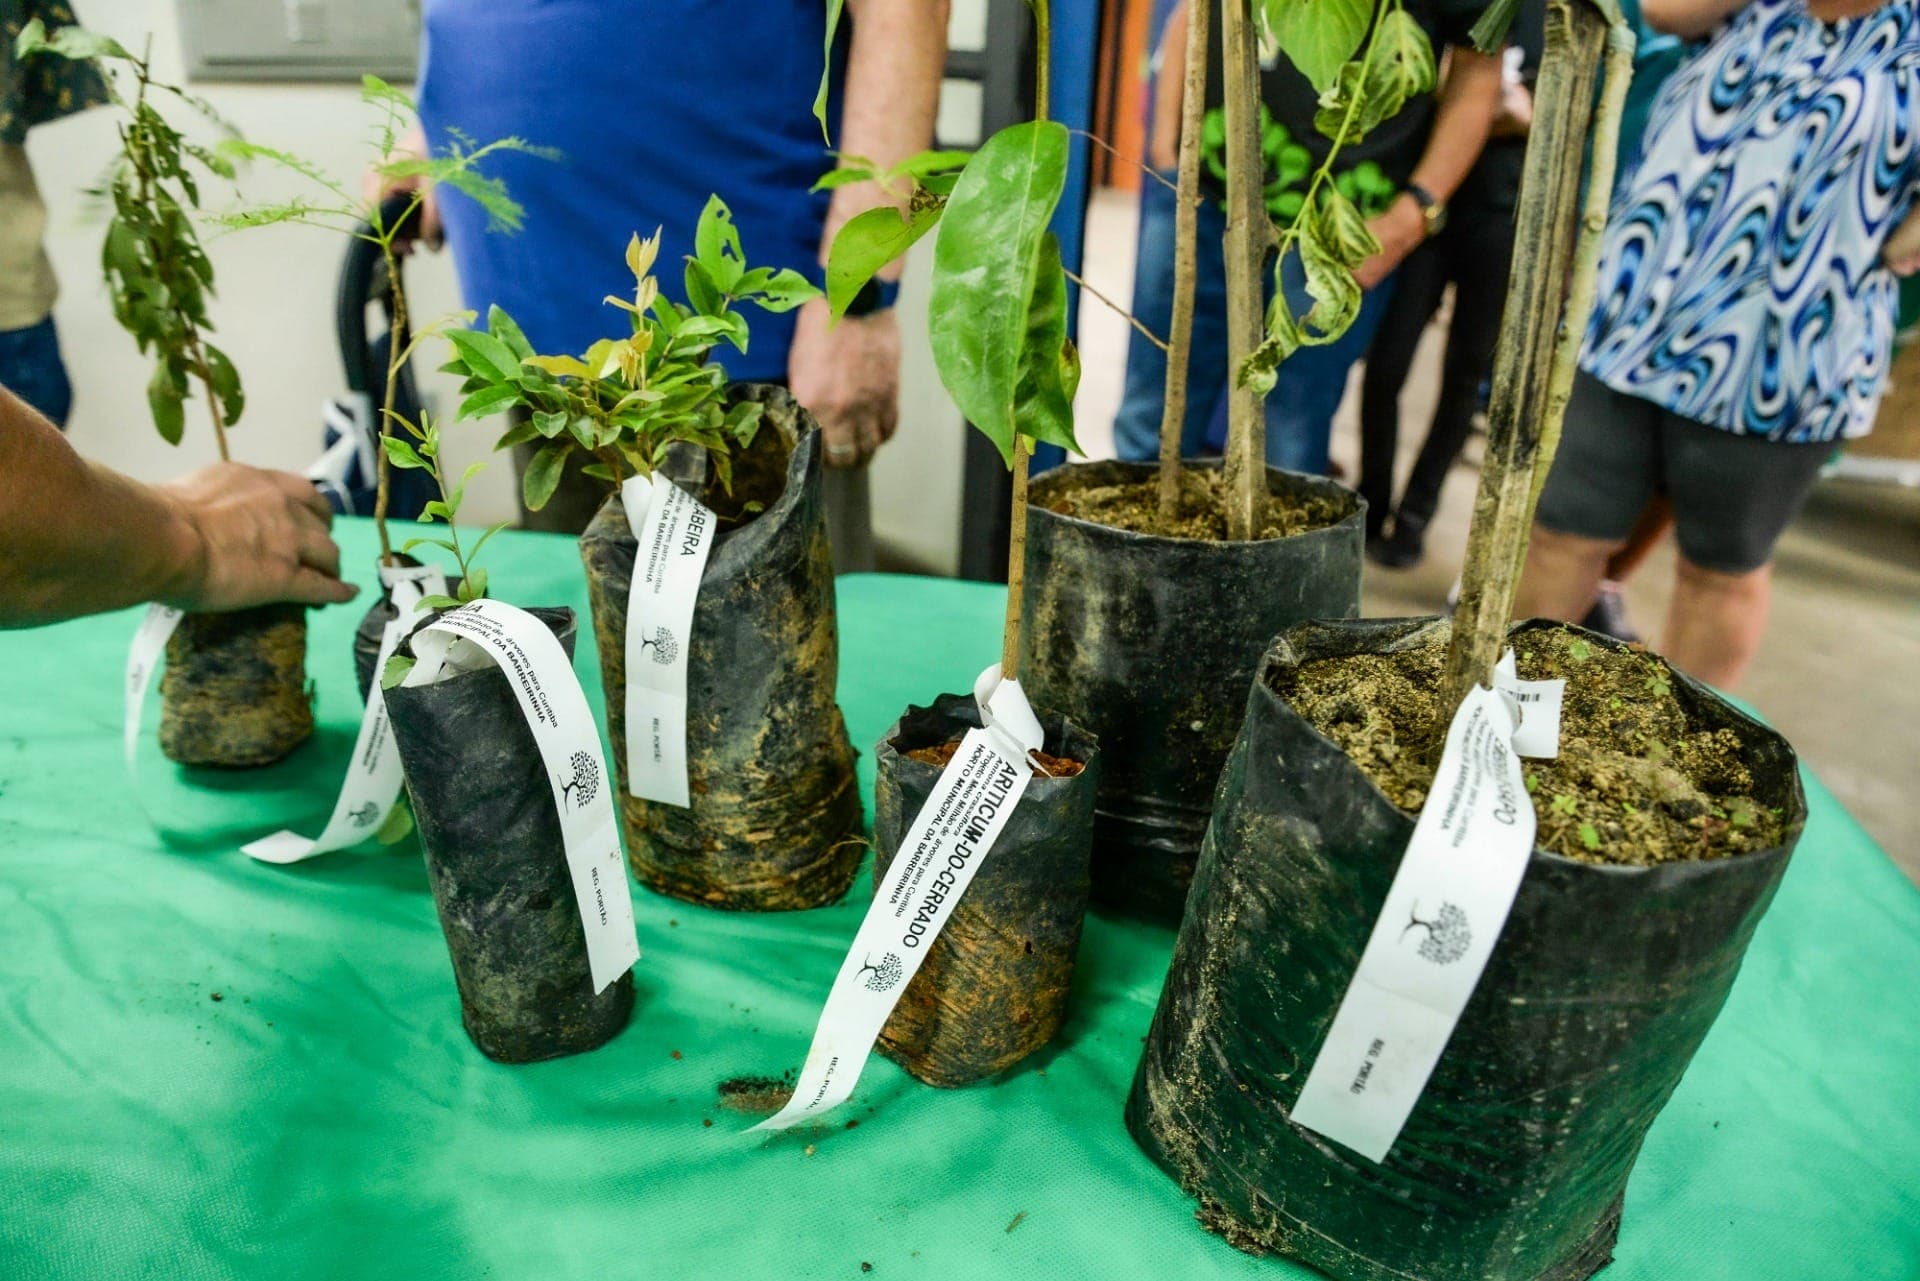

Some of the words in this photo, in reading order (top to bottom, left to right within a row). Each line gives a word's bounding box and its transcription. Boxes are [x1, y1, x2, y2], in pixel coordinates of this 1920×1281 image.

[645, 522, 667, 583] BARREIRINHA
[493, 638, 507, 651] DA
[506, 651, 546, 724] BARREIRINHA
[527, 670, 540, 691] para
[538, 692, 559, 728] Curitiba
[962, 743, 986, 777] HORTO
[974, 750, 997, 779] Projeto
[980, 756, 1003, 790] Annona
[930, 777, 966, 826] MUNICIPAL
[962, 778, 979, 799] Meio
[946, 799, 967, 826] Milhão
[922, 827, 936, 842] DA
[940, 825, 950, 837] de
[902, 760, 1018, 948] ARITICUM-DO-CERRADO
[889, 842, 928, 904] BARREIRINHA
[911, 866, 925, 886] para
[895, 886, 916, 918] Curitiba
